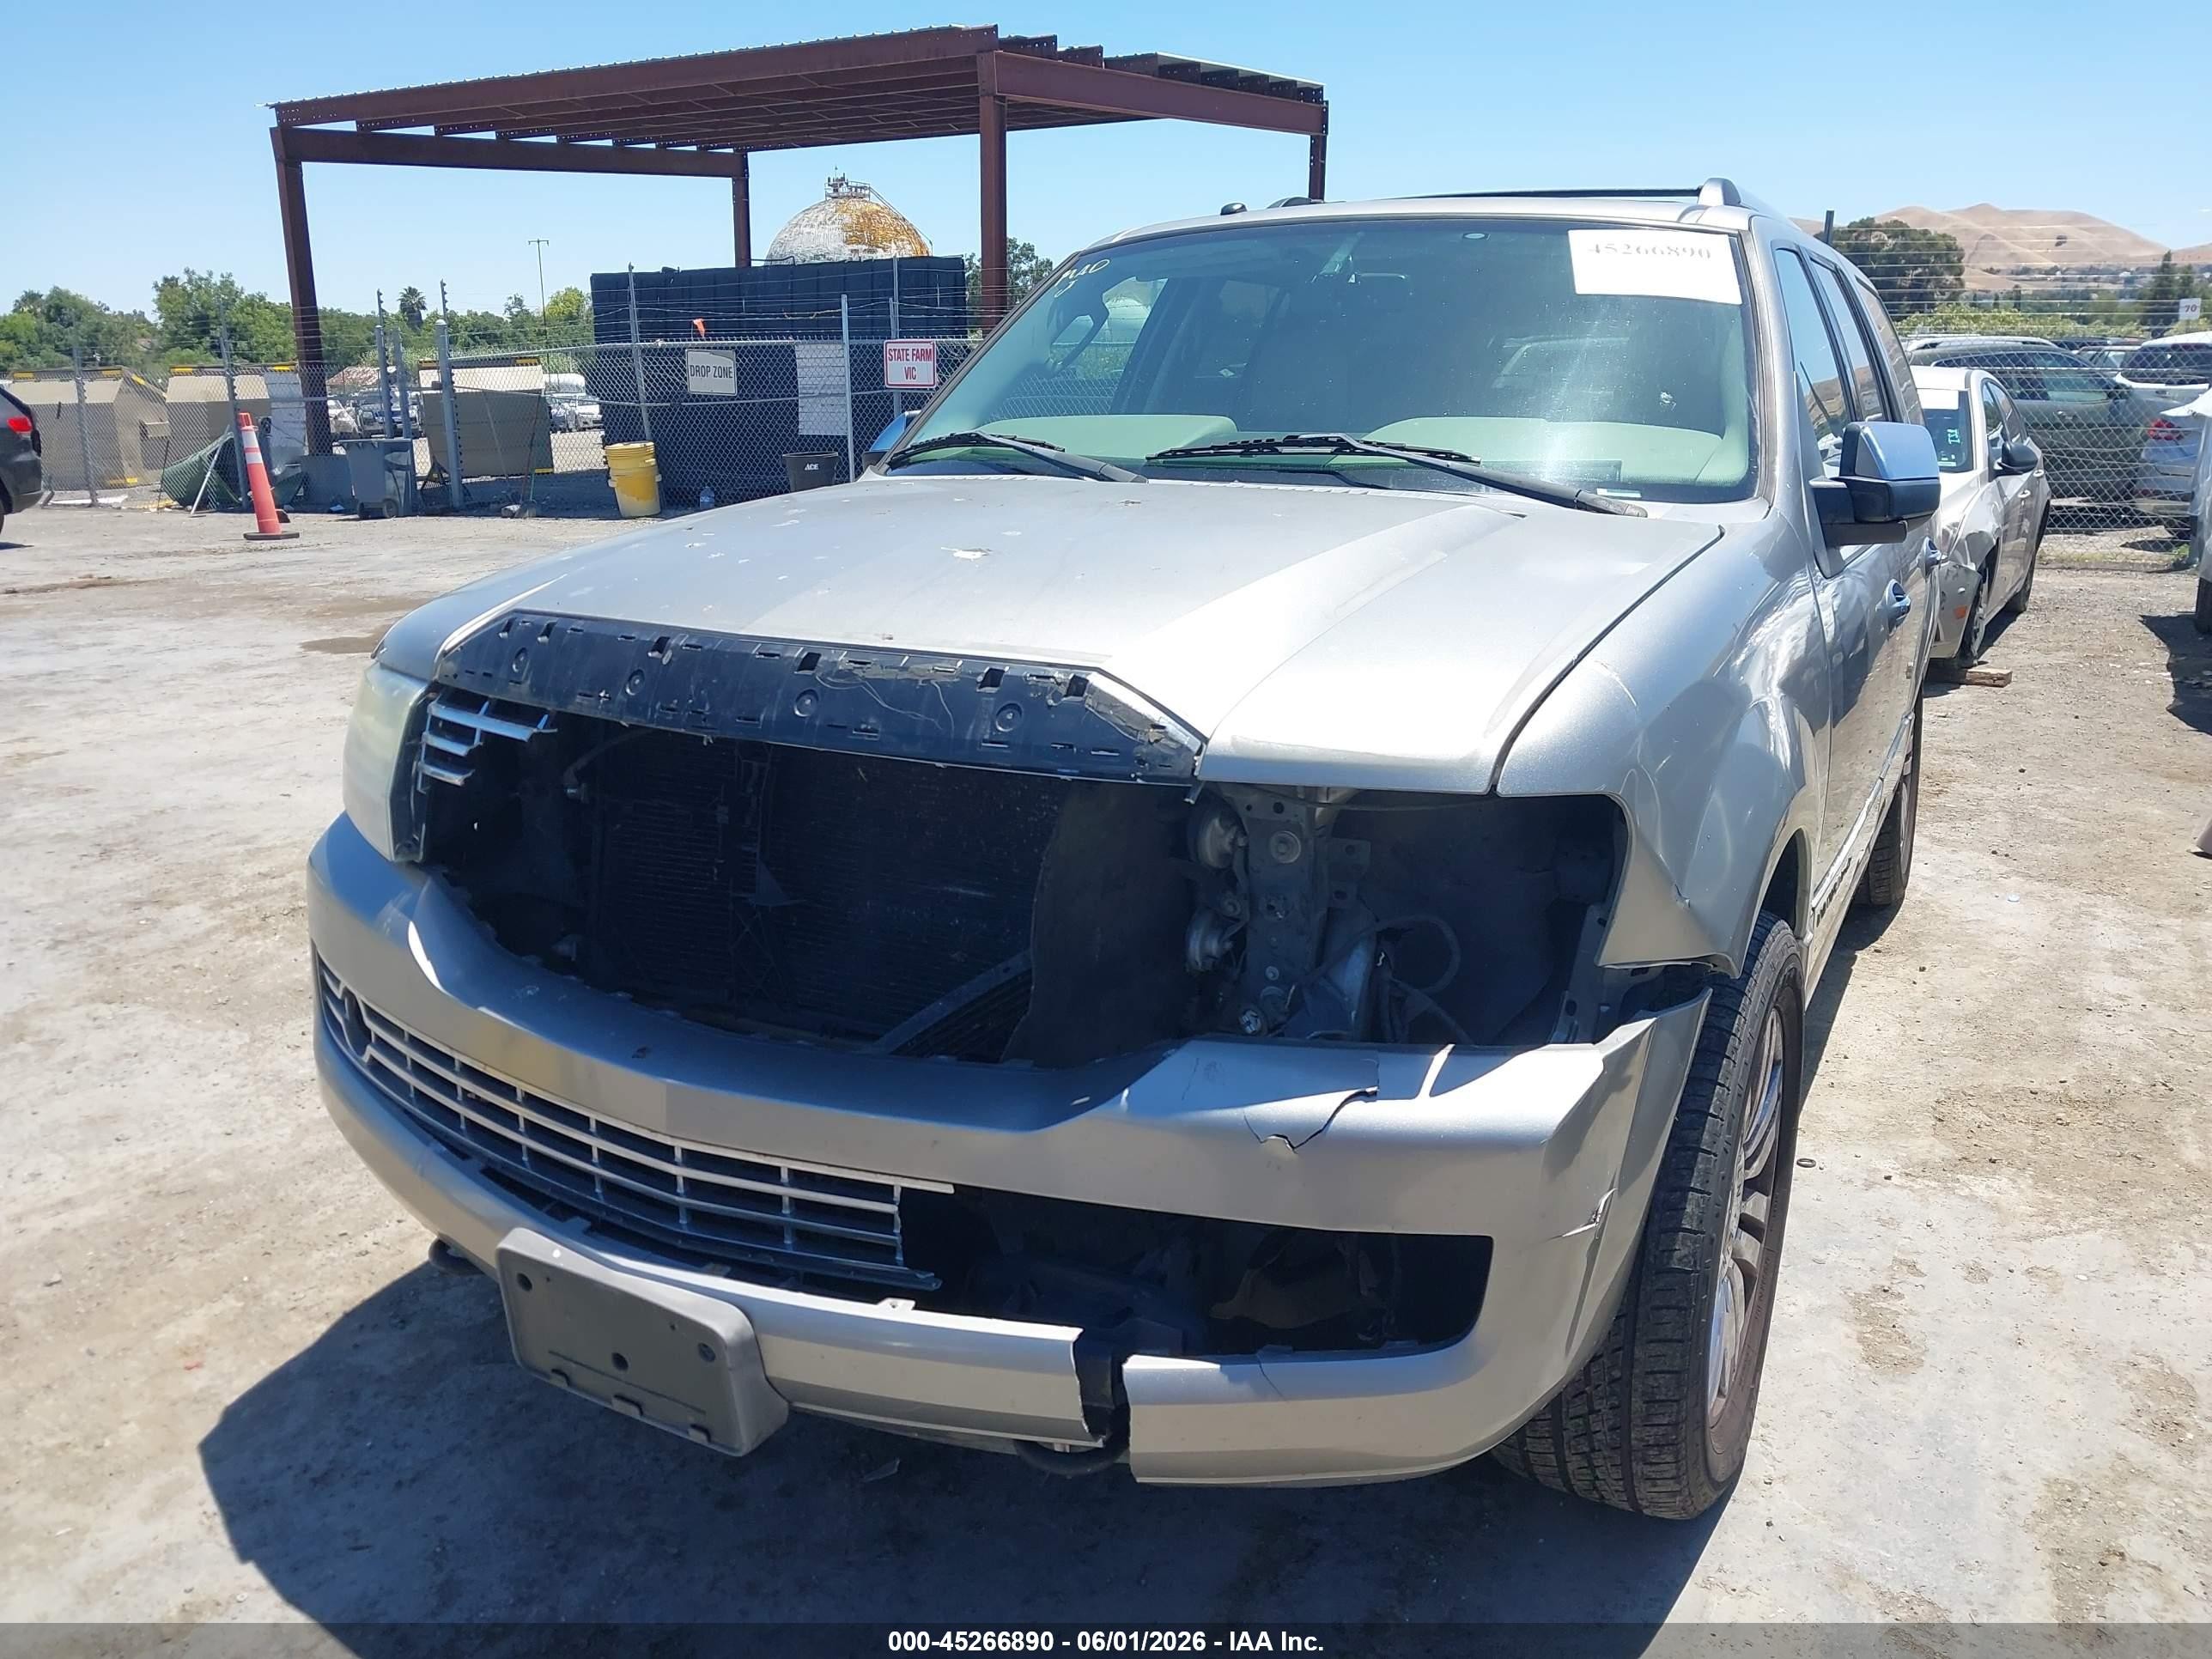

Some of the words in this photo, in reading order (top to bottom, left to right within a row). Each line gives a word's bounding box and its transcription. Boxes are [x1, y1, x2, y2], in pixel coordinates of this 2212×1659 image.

[1589, 242, 1711, 259] 45266890
[2185, 303, 2197, 313] 70
[888, 348, 910, 362] STATE
[911, 348, 933, 362] FARM
[690, 364, 711, 378] DROP
[713, 366, 733, 379] ZONE
[904, 366, 917, 380] VIC
